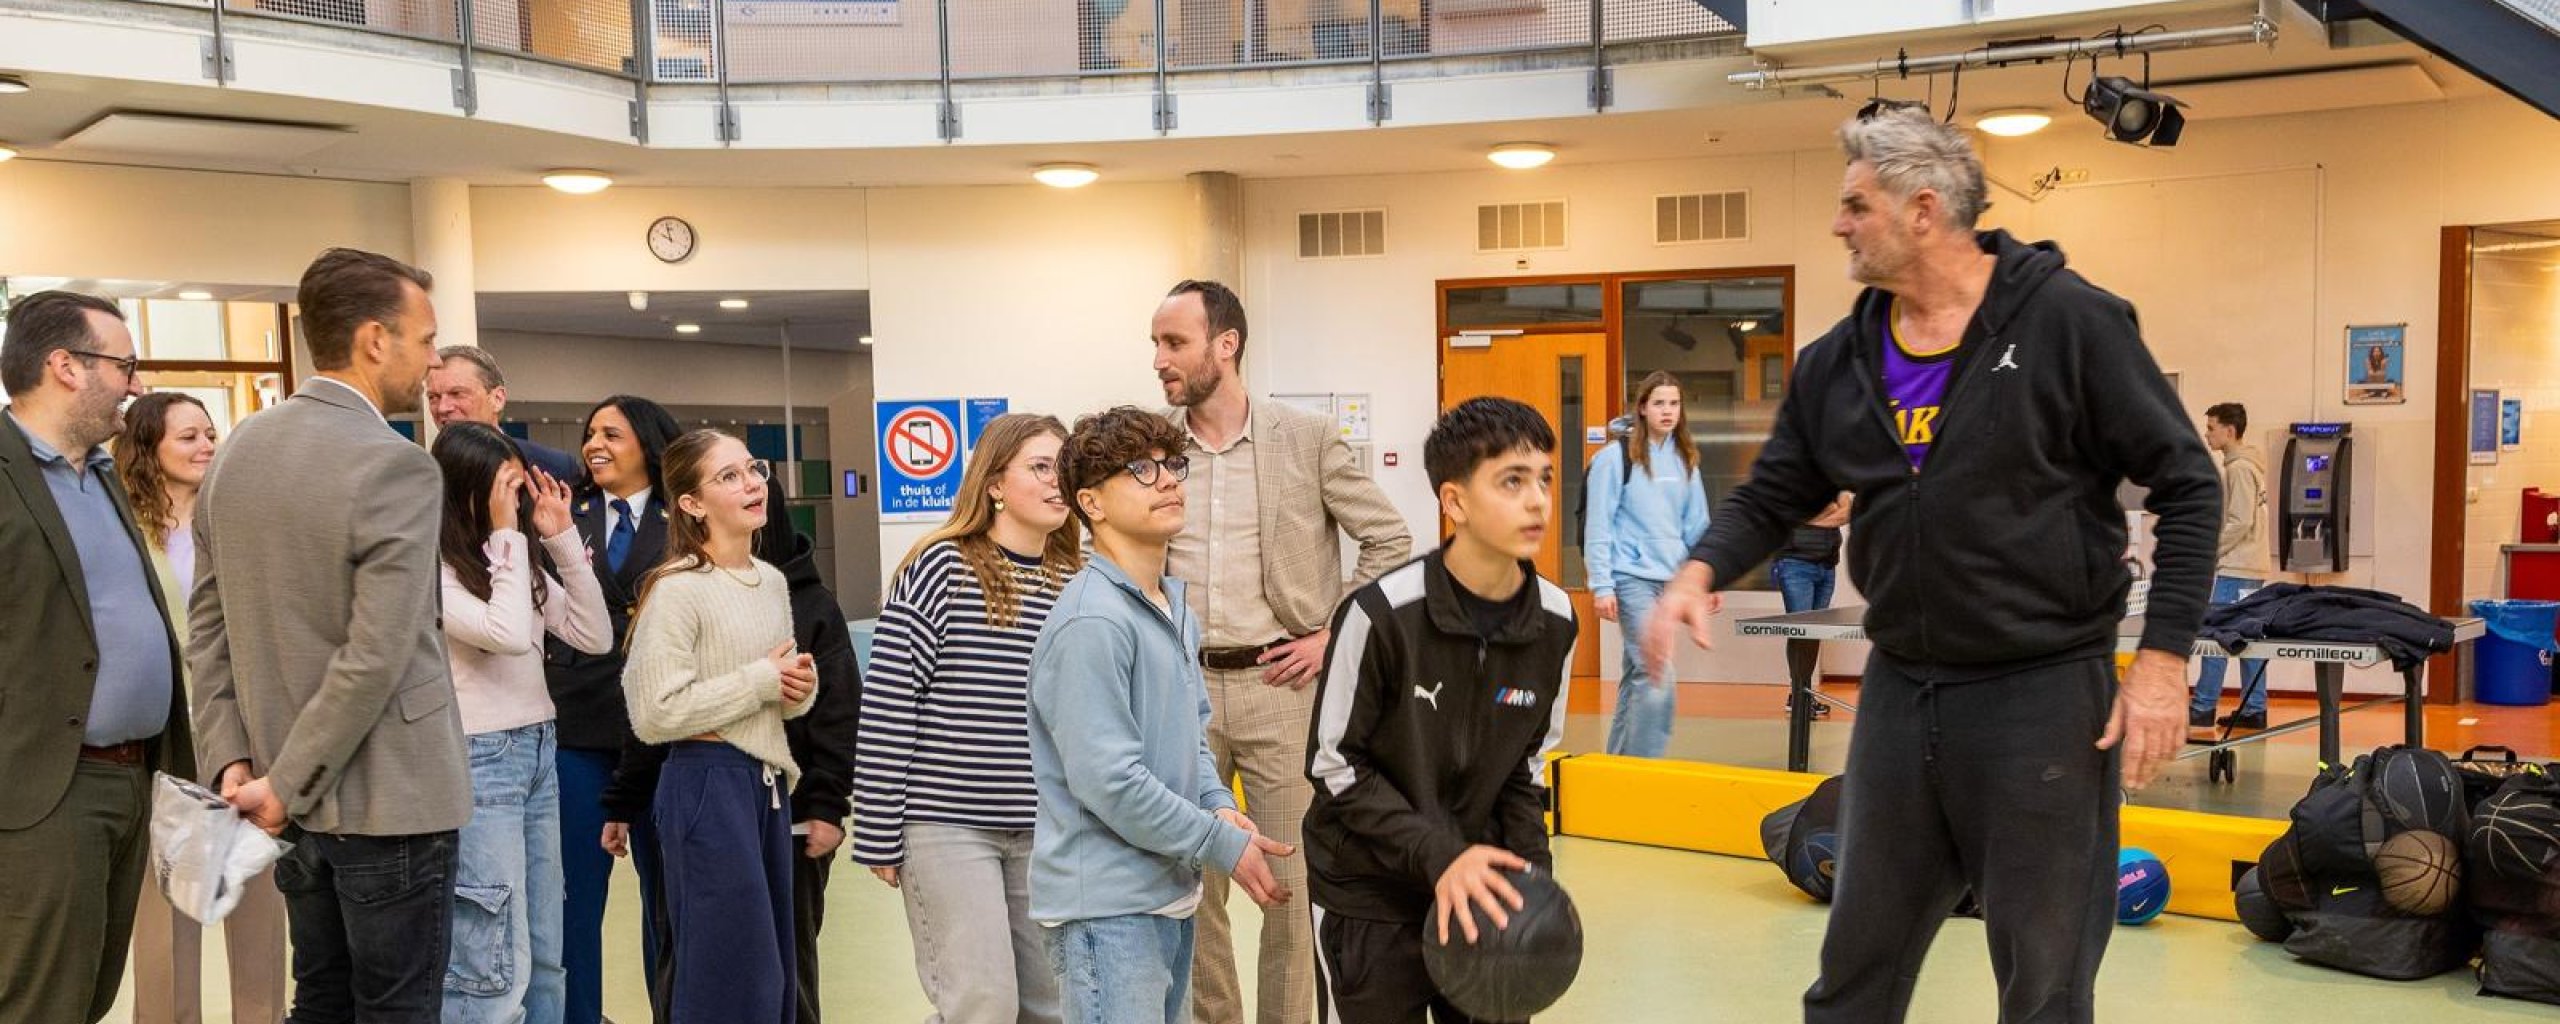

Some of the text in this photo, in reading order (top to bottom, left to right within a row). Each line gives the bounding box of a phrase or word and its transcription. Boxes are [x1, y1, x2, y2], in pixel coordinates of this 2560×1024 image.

[900, 483, 946, 496] thuis of
[892, 497, 903, 508] in
[905, 497, 919, 507] de
[1743, 625, 1806, 636] cornilleau
[2277, 647, 2363, 660] cornilleau
